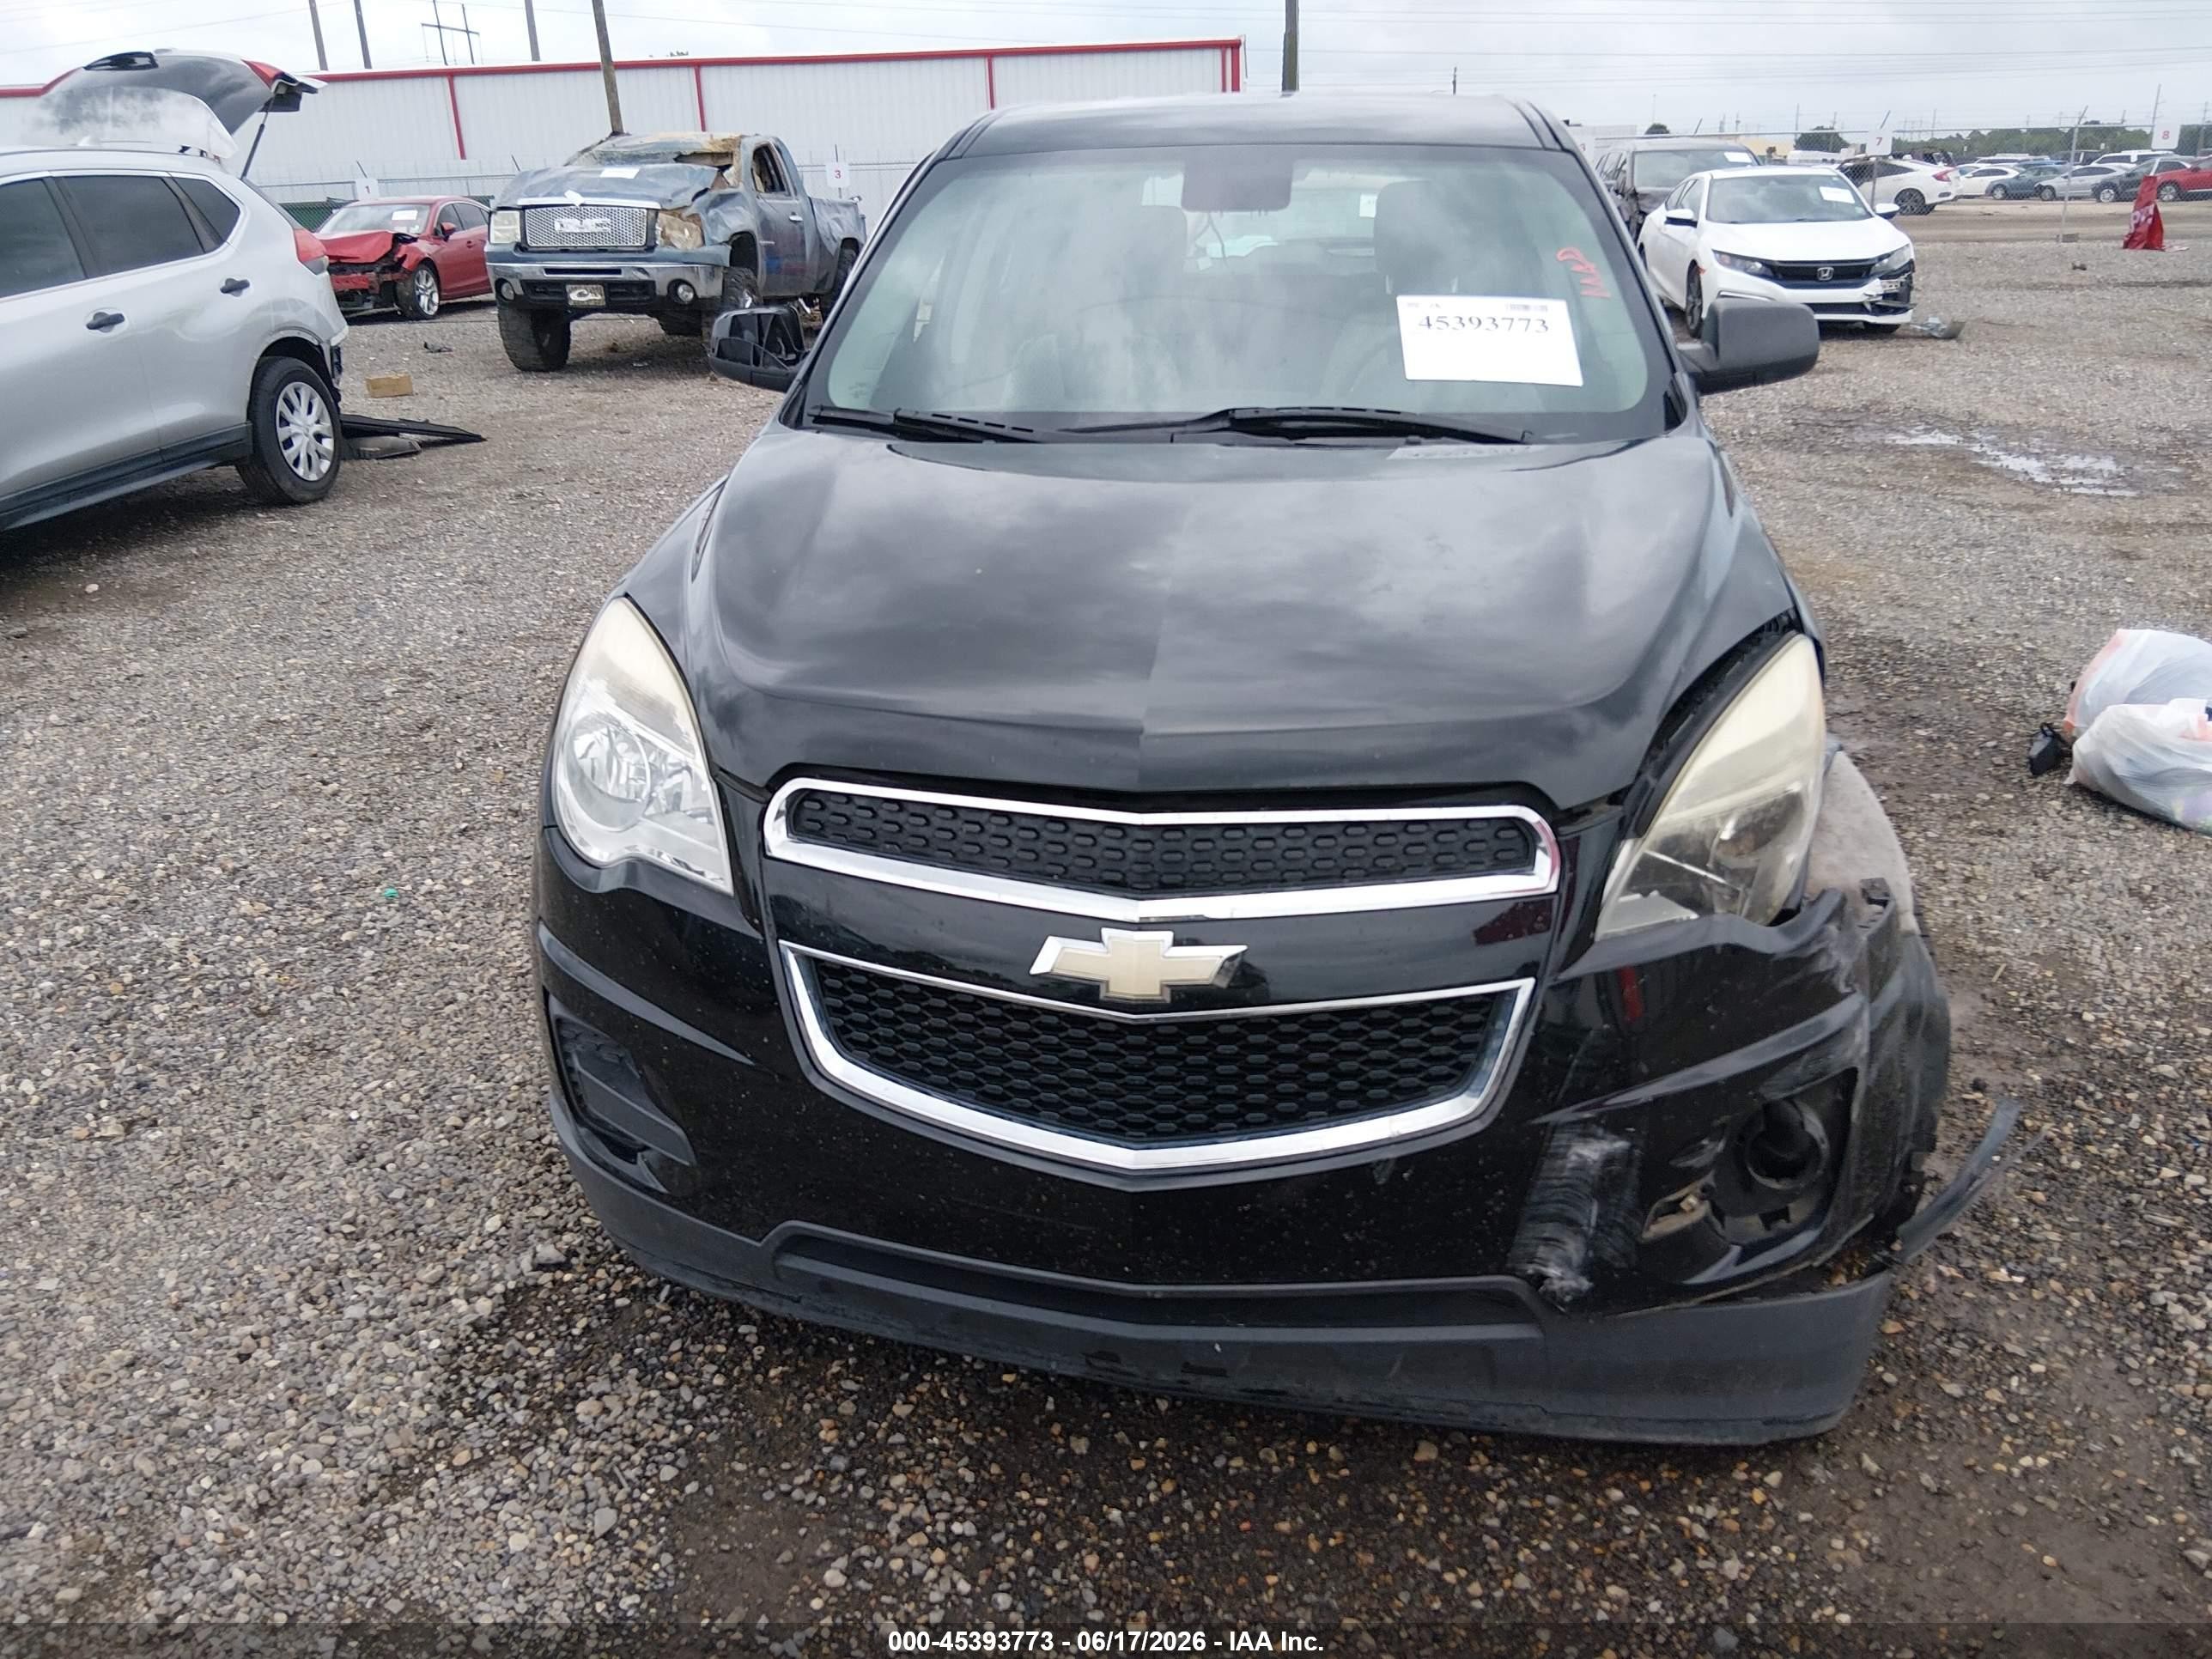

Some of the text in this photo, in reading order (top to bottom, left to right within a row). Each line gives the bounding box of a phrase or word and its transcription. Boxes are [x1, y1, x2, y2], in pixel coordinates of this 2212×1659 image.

[2161, 130, 2170, 140] 8
[1875, 137, 1883, 146] 7
[834, 169, 842, 179] 3
[1418, 315, 1549, 334] 45393773
